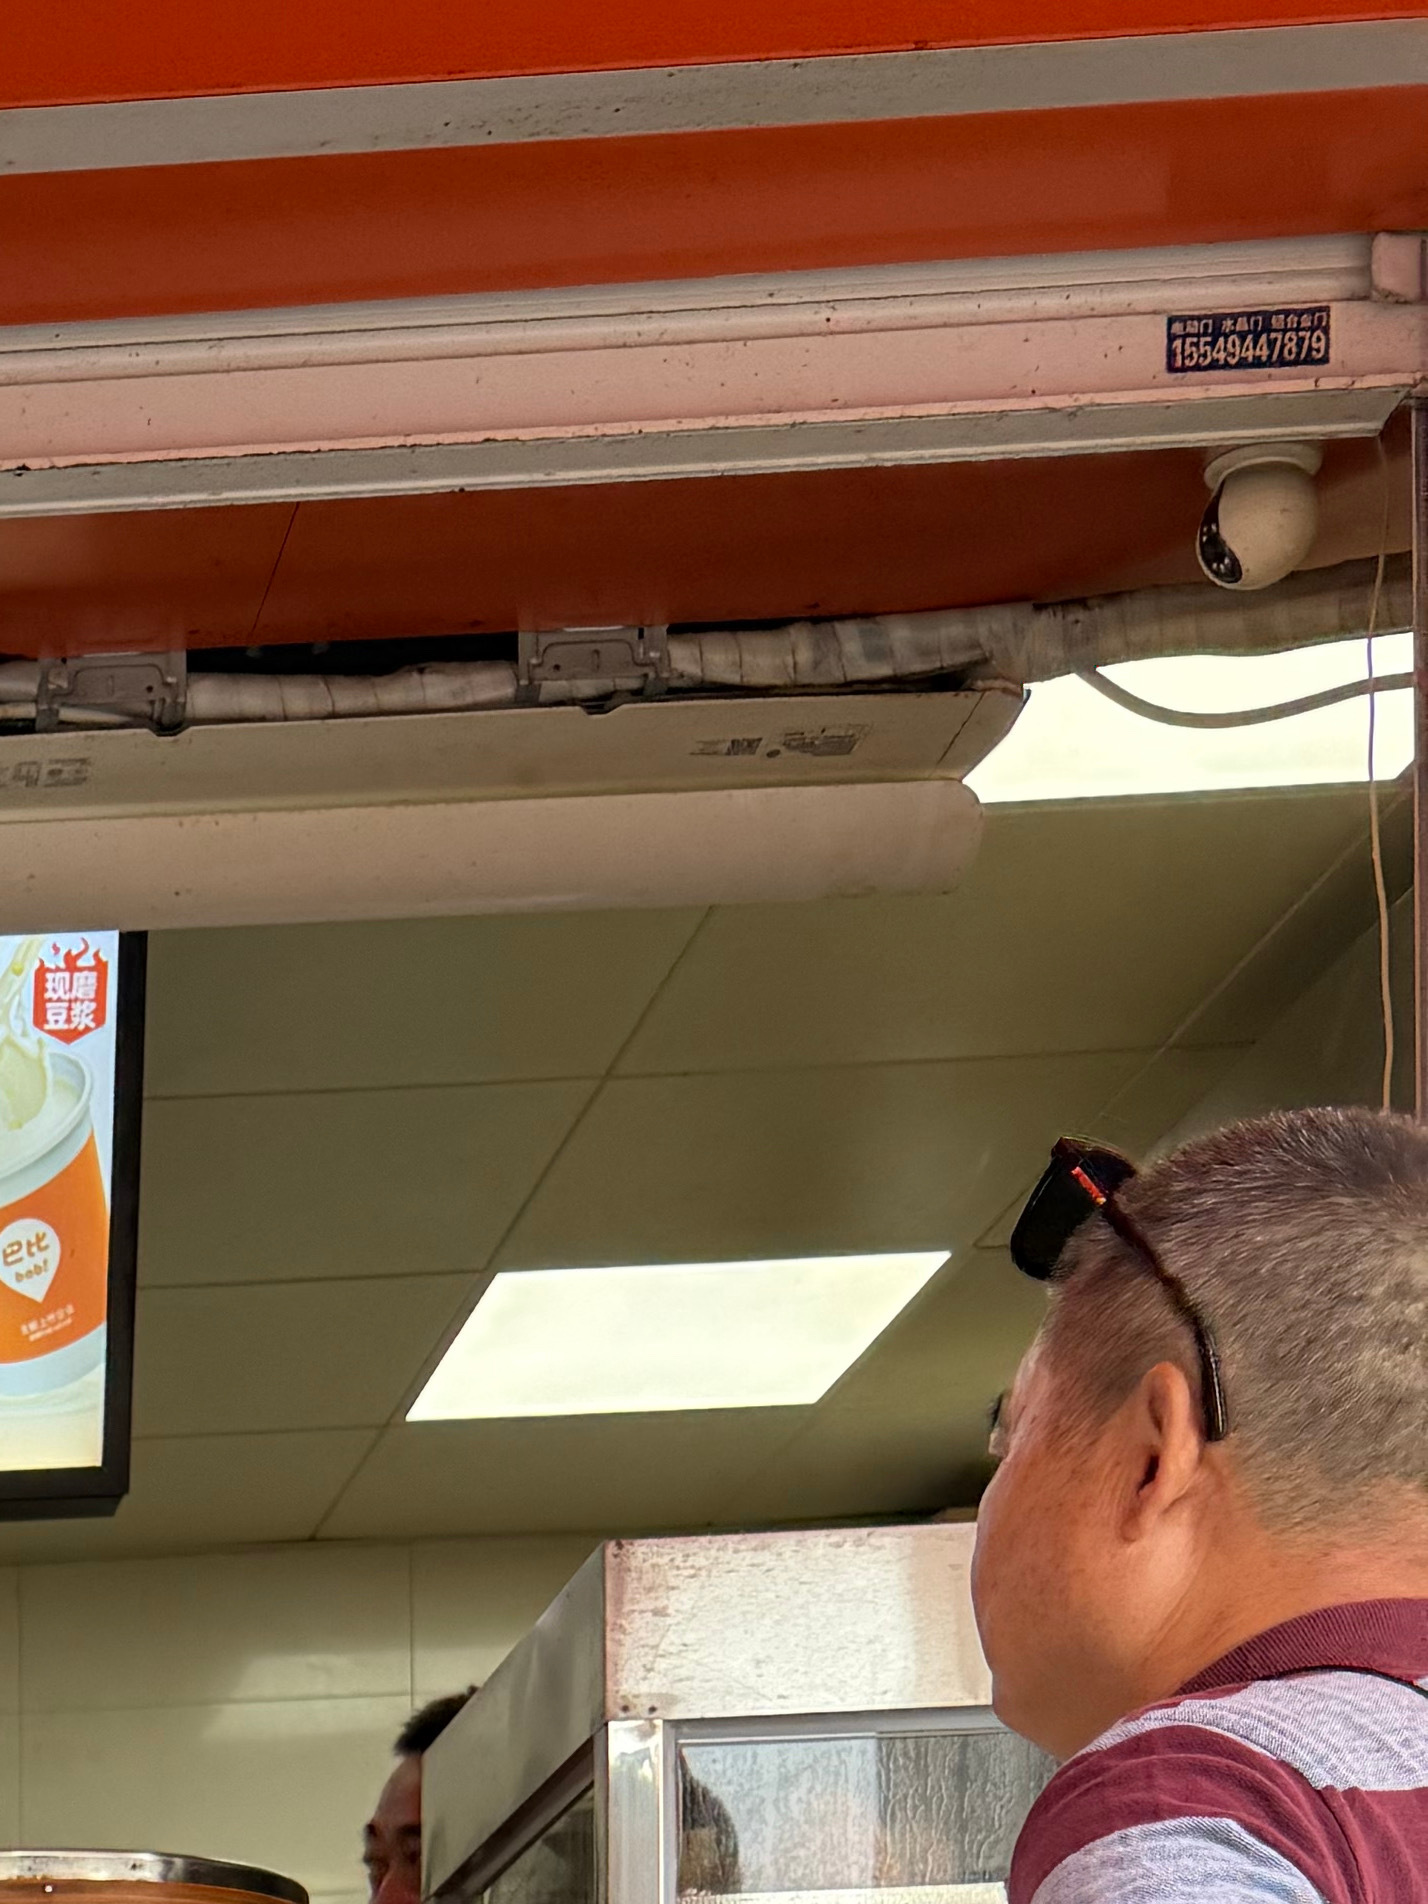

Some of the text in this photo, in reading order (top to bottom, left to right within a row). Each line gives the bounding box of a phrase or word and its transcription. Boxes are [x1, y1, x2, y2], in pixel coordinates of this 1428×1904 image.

[1172, 330, 1327, 369] 15549447879
[44, 1001, 96, 1031] 豆浆
[2, 1232, 50, 1267] 巴比
